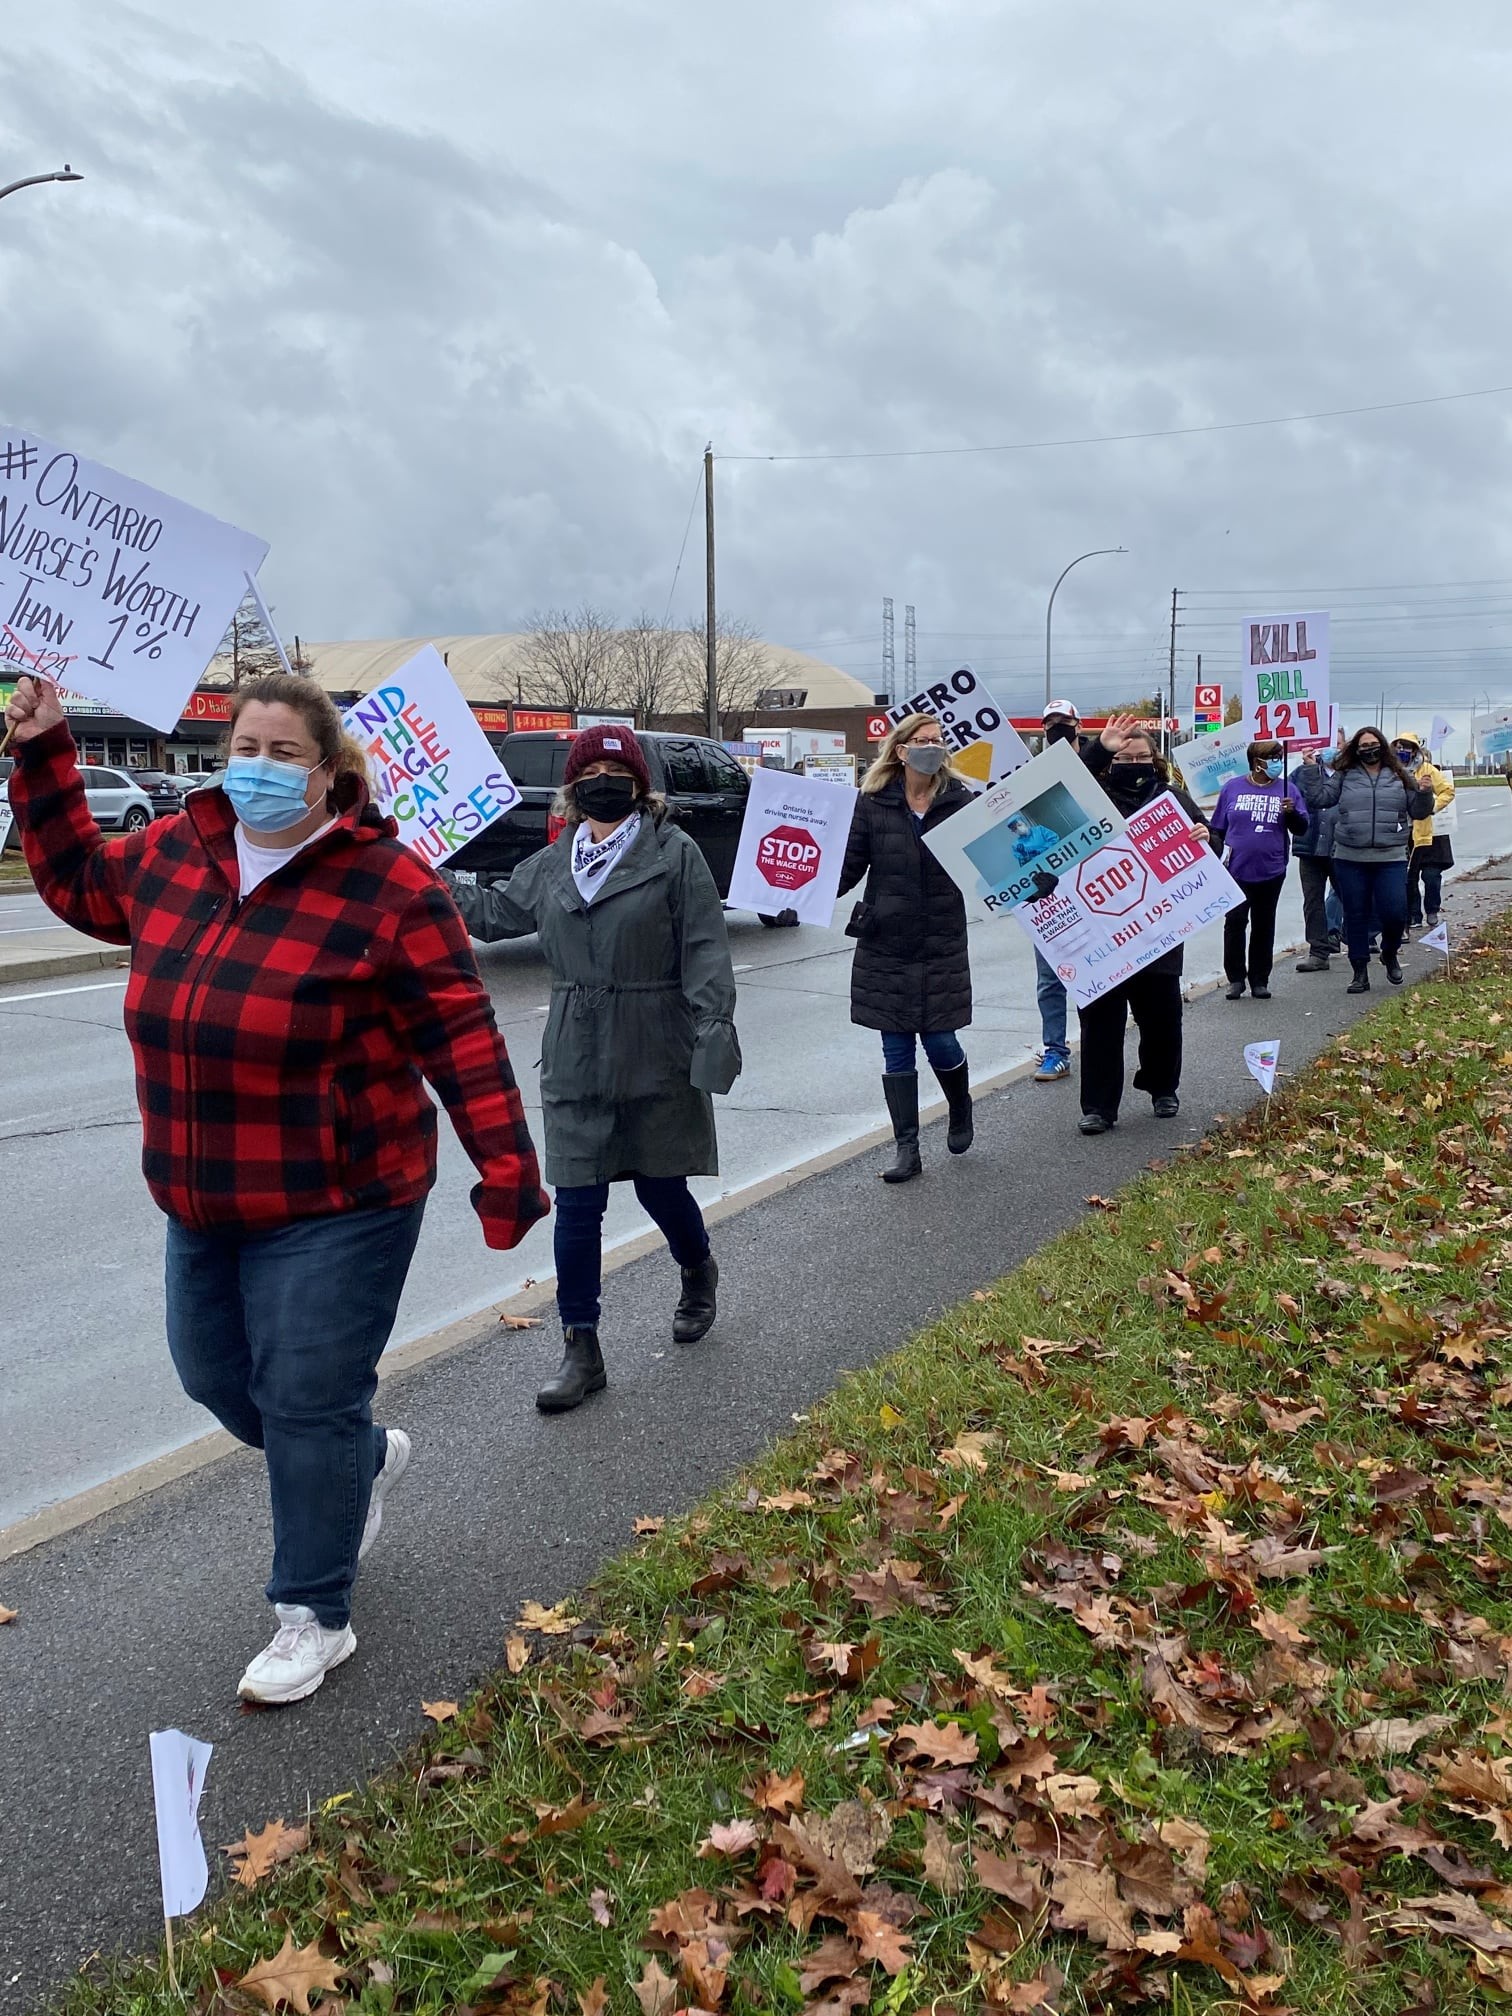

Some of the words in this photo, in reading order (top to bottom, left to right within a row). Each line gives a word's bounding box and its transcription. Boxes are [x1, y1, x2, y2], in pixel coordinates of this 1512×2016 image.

[102, 548, 200, 637] WORTH
[8, 571, 73, 645] THAN
[88, 615, 168, 670] 1%
[1250, 621, 1317, 665] KILL
[33, 648, 70, 682] 124
[889, 669, 977, 725] HERO
[1257, 670, 1308, 703] BILL
[366, 703, 437, 765] THE
[1254, 701, 1319, 741] 124
[393, 763, 450, 822] CAP
[987, 790, 1011, 809] ONA
[1234, 802, 1268, 812] PROTECT
[1236, 794, 1269, 803] RESPECT
[418, 807, 447, 829] 4
[764, 808, 788, 819] driving
[788, 814, 809, 823] nurses
[782, 804, 807, 815] Ontario
[1147, 802, 1176, 825] TIME,
[1250, 811, 1266, 822] PAY
[761, 837, 818, 863] STOP
[1139, 835, 1160, 854] WE
[1156, 819, 1184, 843] NEED
[761, 856, 775, 866] THE
[776, 859, 798, 870] WAGE
[797, 864, 815, 873] CUT!
[983, 863, 1046, 912] Repel
[1045, 841, 1079, 871] Bill
[1079, 817, 1113, 847] 195
[1160, 843, 1195, 875] YOU
[1085, 858, 1136, 906] STOP
[1030, 895, 1072, 927] WORTH
[1031, 903, 1039, 913] I
[1039, 893, 1058, 910] AM
[1036, 917, 1058, 935] MORE
[1058, 905, 1077, 921] THAN
[1042, 932, 1050, 941] A
[1047, 920, 1068, 937] WAGE
[1084, 942, 1118, 967] KILL
[1111, 920, 1144, 948] Bill
[1144, 898, 1173, 925] 195
[1076, 980, 1106, 999] We
[1108, 962, 1134, 983] need
[1135, 946, 1161, 966] more
[1178, 921, 1194, 937] not
[1195, 892, 1233, 925] LESS!
